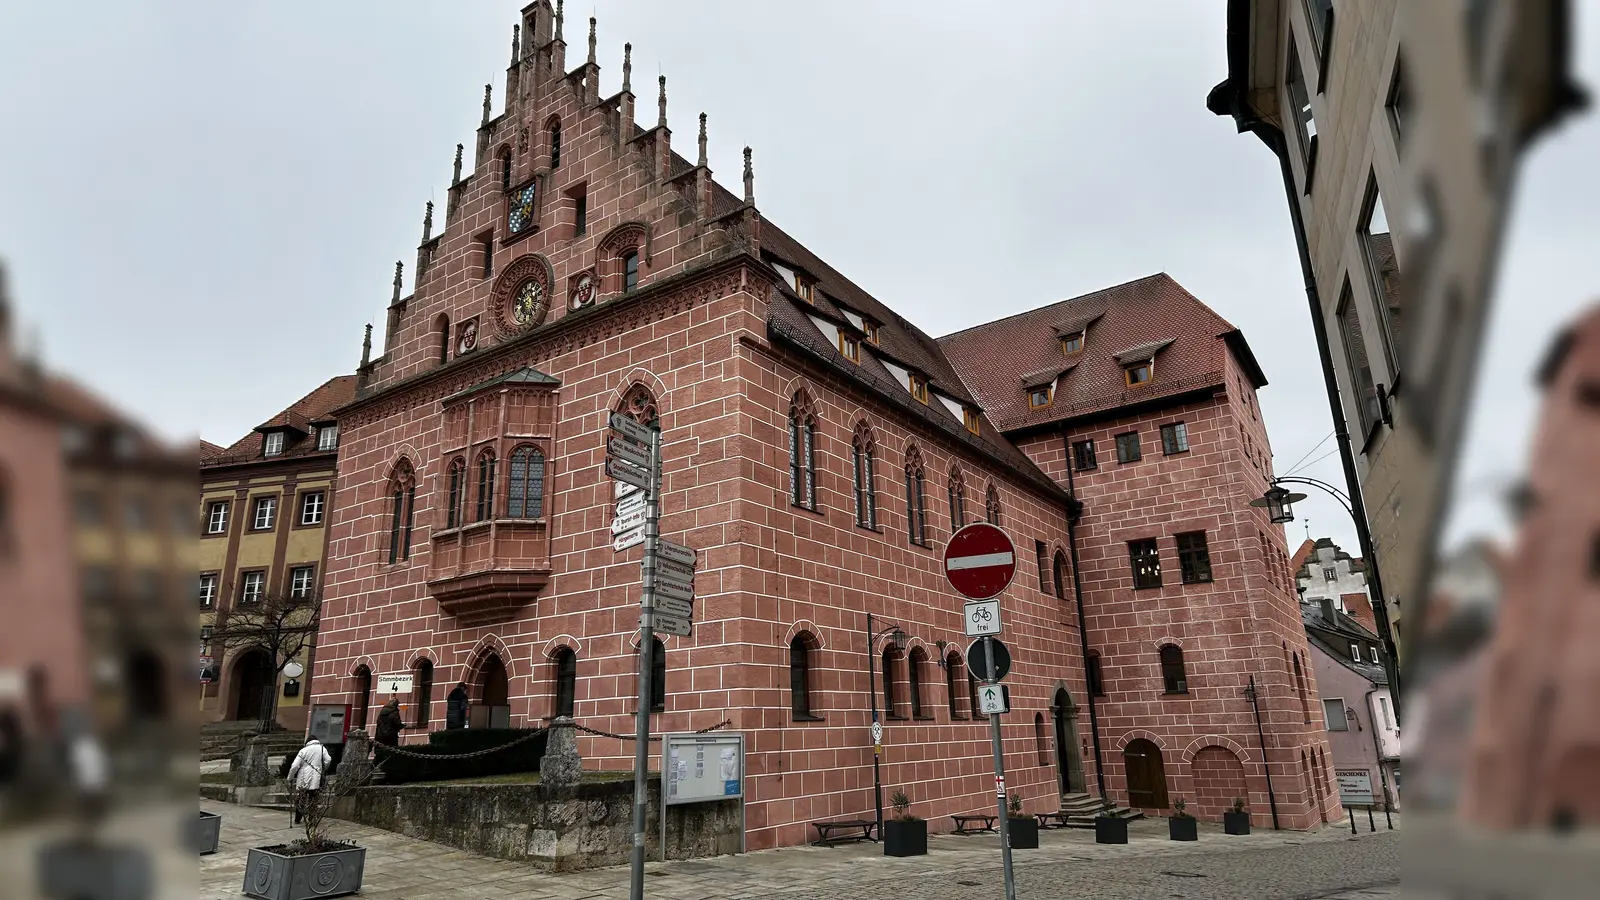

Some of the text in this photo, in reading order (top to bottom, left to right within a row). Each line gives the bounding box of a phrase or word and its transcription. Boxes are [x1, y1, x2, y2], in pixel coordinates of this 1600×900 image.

[613, 463, 642, 479] Stadtbibliothek
[621, 513, 640, 524] Tourist-Info
[664, 544, 692, 557] Literaturarchiv
[977, 623, 988, 631] frei
[392, 682, 398, 692] 4
